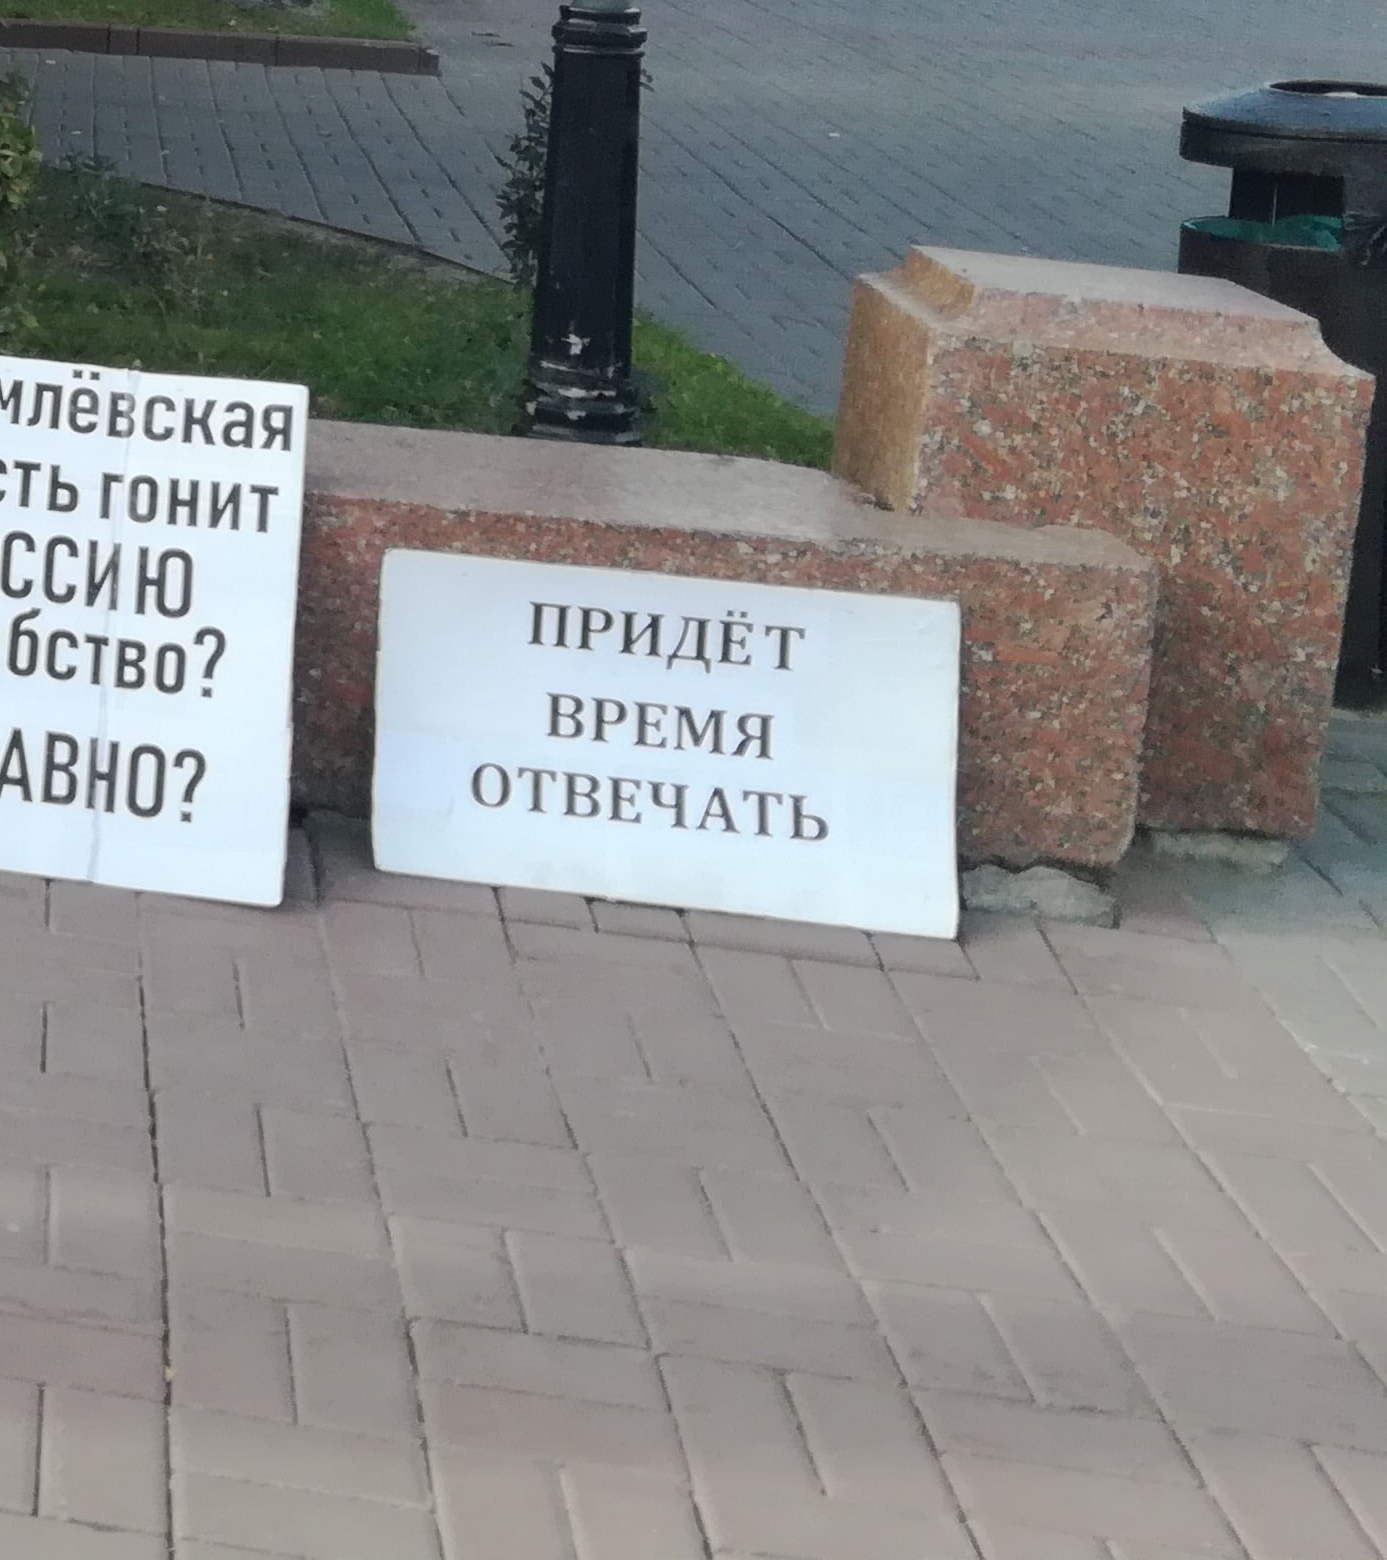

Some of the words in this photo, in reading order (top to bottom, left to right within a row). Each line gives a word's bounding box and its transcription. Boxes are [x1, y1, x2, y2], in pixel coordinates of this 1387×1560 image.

[99, 470, 280, 534] гонит
[528, 600, 807, 674] ПРИДЁТ
[545, 691, 776, 761] ВРЕМЯ
[470, 760, 830, 843] ОТВЕЧАТЬ
